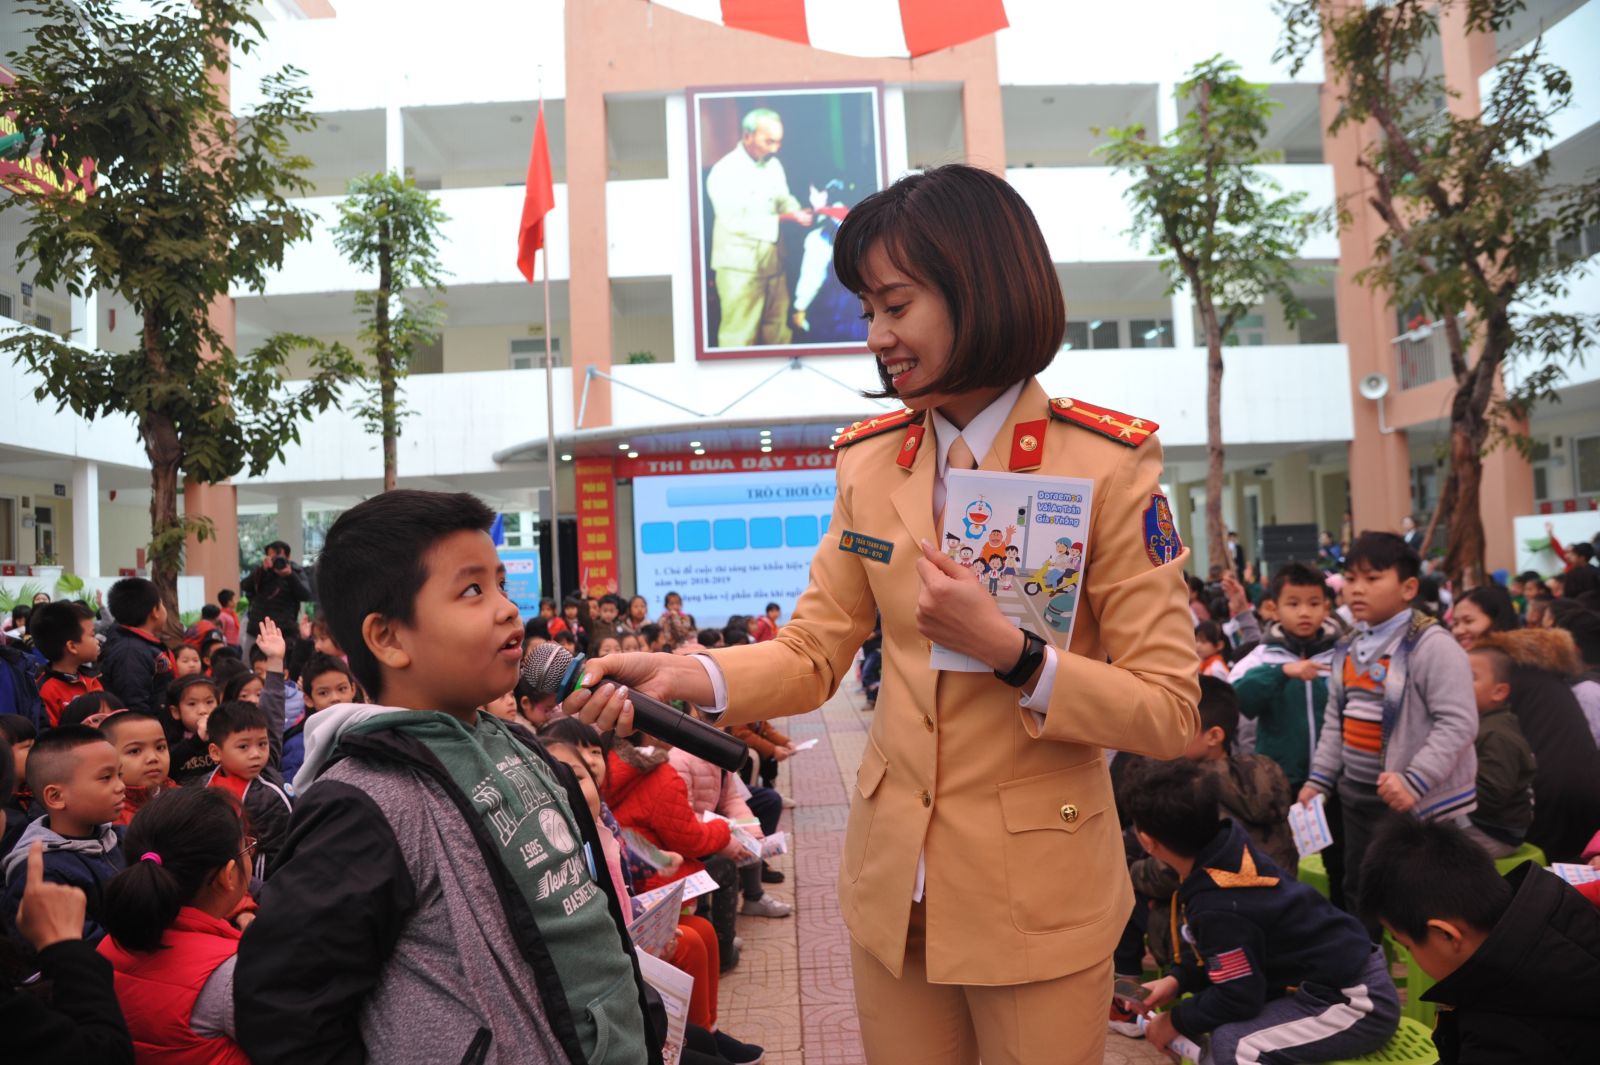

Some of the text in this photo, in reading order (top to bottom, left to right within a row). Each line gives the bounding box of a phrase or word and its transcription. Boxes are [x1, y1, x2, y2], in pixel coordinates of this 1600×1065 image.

[650, 460, 683, 473] THI
[794, 453, 834, 467] TỐT
[746, 486, 773, 499] TRÒ
[825, 485, 837, 496] C
[1038, 491, 1082, 502] Doraemon
[1051, 504, 1062, 513] An
[520, 838, 544, 861] 1985
